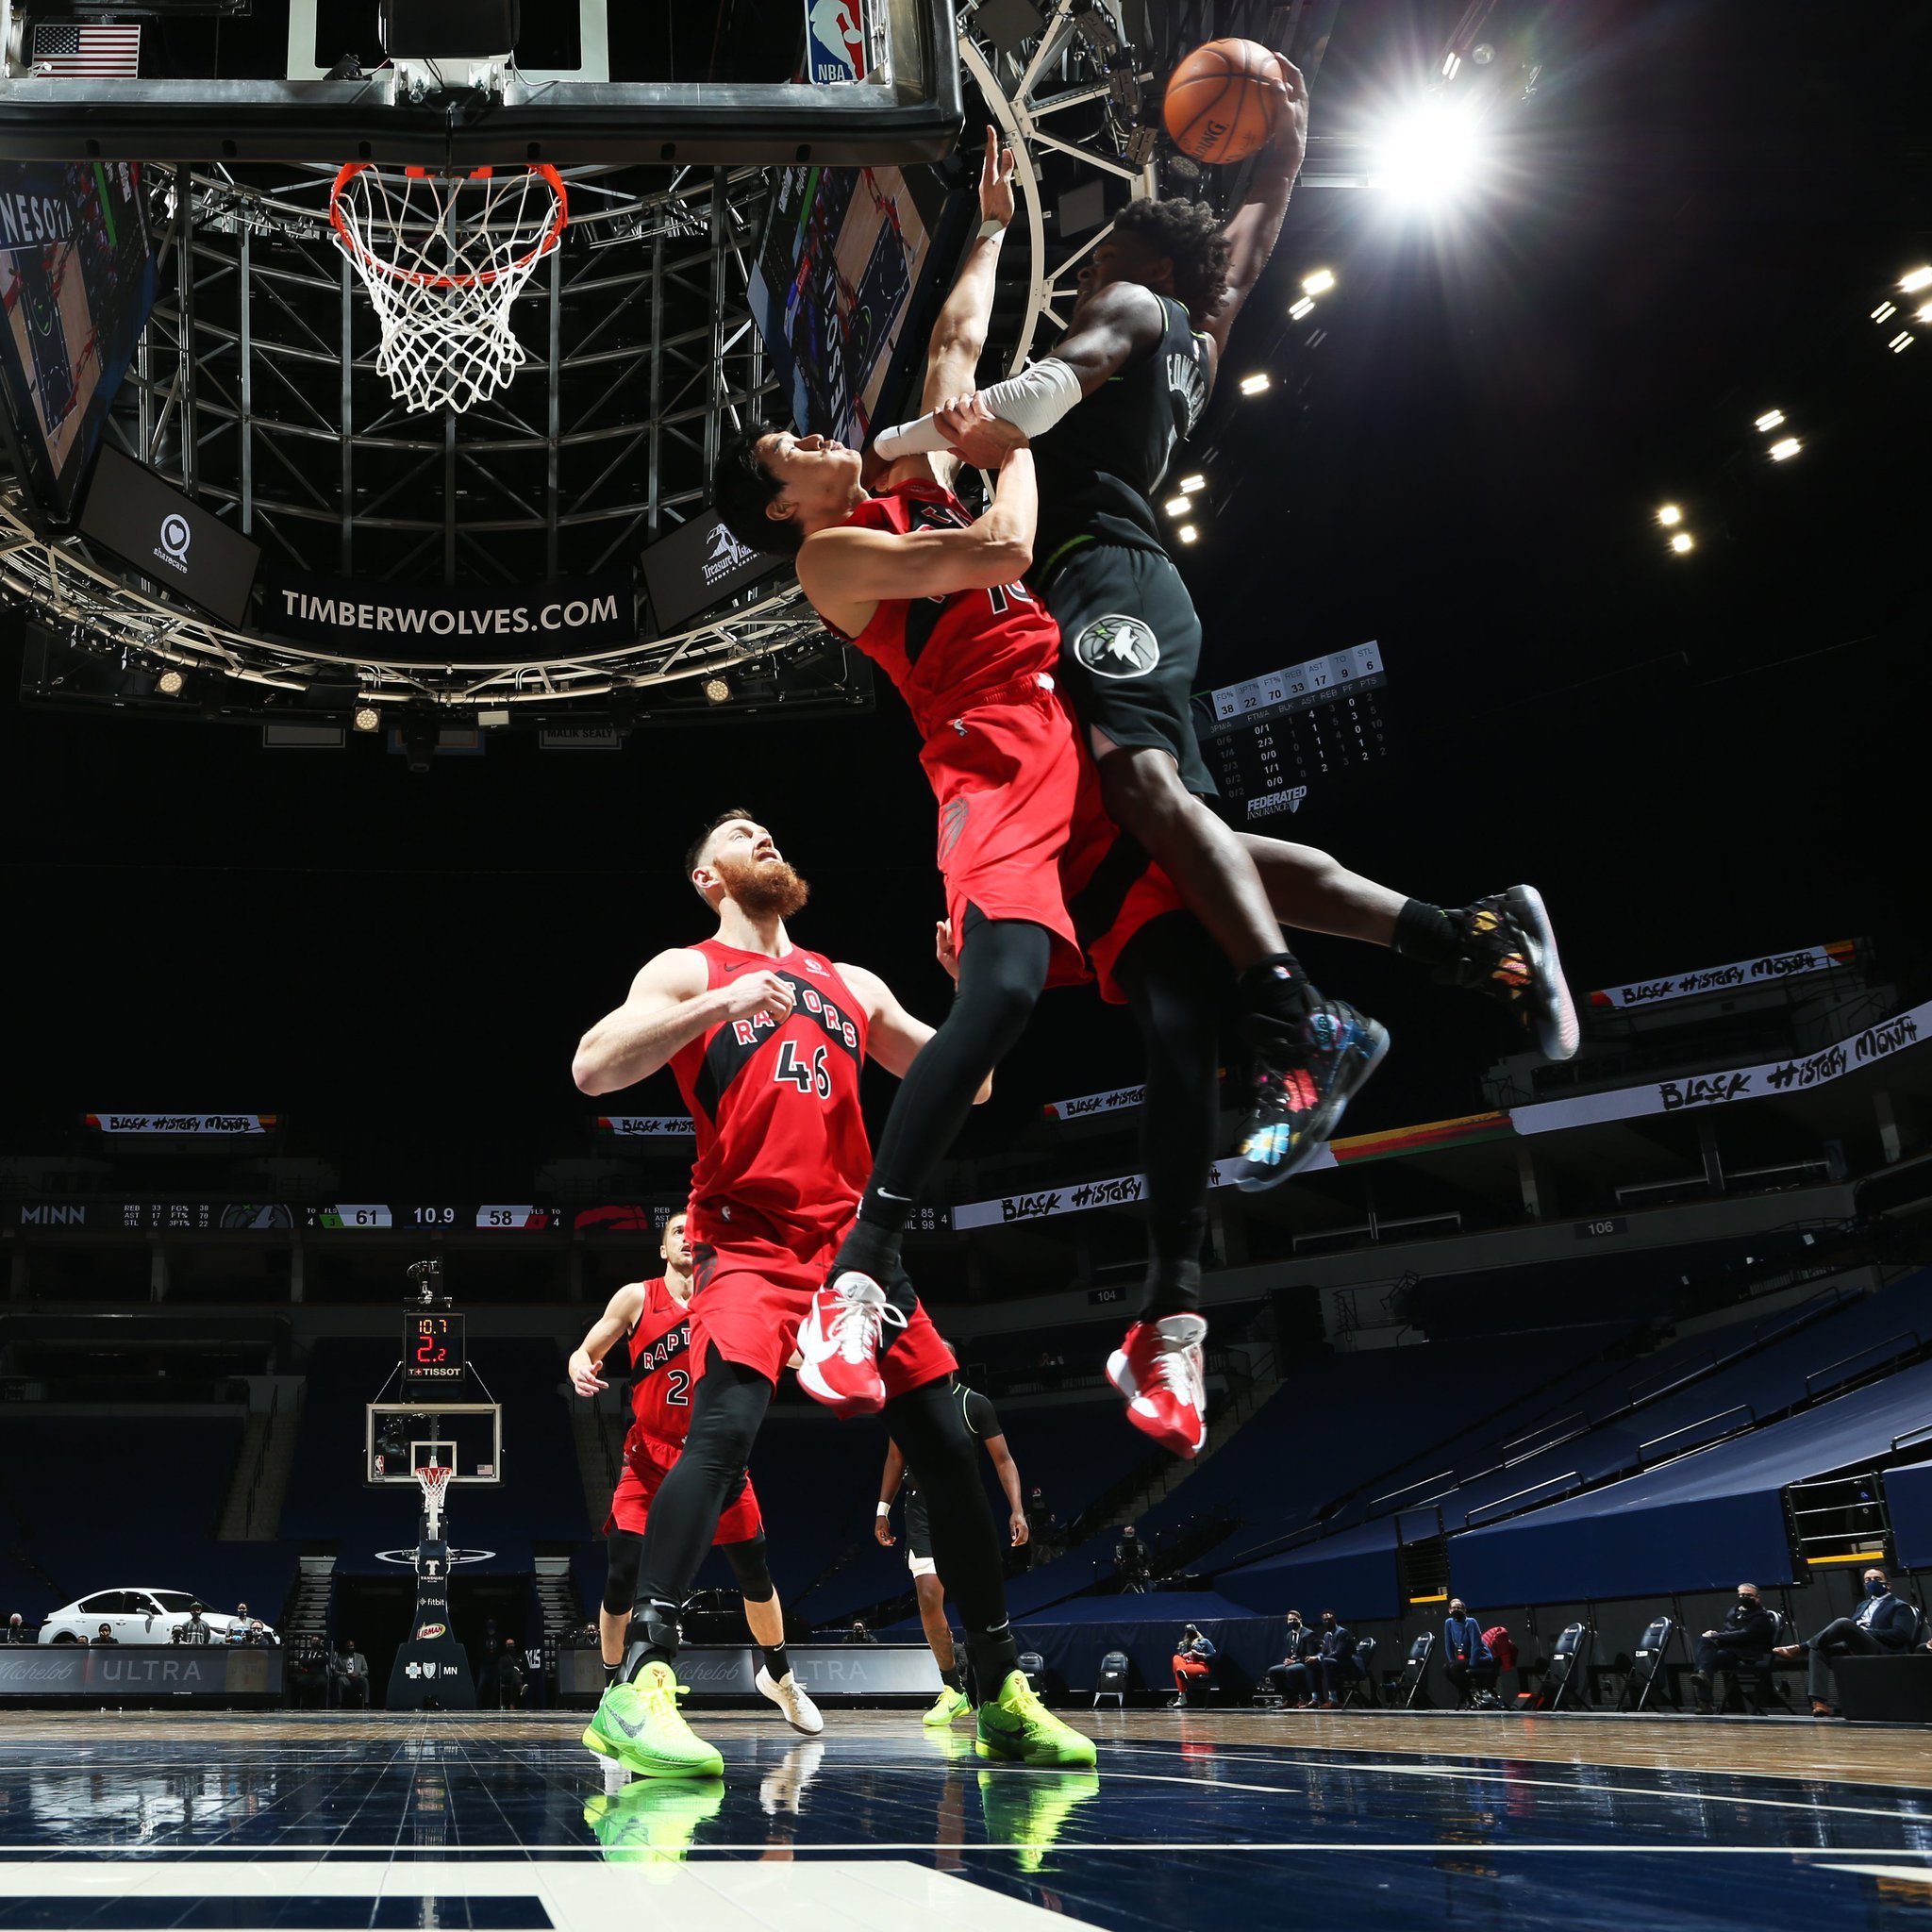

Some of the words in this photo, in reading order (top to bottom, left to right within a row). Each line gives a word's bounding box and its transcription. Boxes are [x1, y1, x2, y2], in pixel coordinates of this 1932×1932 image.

[818, 64, 845, 81] NBA
[153, 547, 188, 574] sharecare
[702, 555, 733, 579] Treasure
[281, 590, 618, 635] TIMBERWOLVES.COM
[1216, 691, 1234, 701] FG%
[1264, 676, 1281, 686] FT%
[1285, 670, 1302, 679] REB
[1308, 662, 1325, 672] AST
[1334, 656, 1346, 664] TO
[1357, 648, 1374, 657] STL
[1221, 704, 1234, 715] 38
[1244, 697, 1257, 708] 22
[1268, 690, 1282, 701] 70
[1291, 682, 1305, 693] 33
[1314, 675, 1326, 686] 17
[1341, 669, 1348, 677] 9
[1366, 660, 1374, 670] 6
[1302, 694, 1316, 705] AST
[1321, 689, 1338, 699] REB
[1342, 683, 1354, 692] PF
[1360, 677, 1377, 687] PTS
[1254, 724, 1270, 735] 0/1
[1308, 709, 1315, 718] 4
[1348, 698, 1356, 707] 0
[582, 728, 612, 738] SEALY
[1257, 737, 1274, 748] 2/3
[1312, 724, 1317, 732] 1
[1351, 711, 1358, 720] 3
[1260, 750, 1276, 760] 0/0
[1315, 737, 1321, 745] 1
[1355, 724, 1361, 734] 0
[1264, 762, 1279, 774] 1/1
[1319, 750, 1324, 758] 1
[1358, 738, 1364, 747] 1
[1267, 776, 1283, 788] 0/0
[1321, 763, 1328, 773] 2
[1361, 752, 1369, 761] 2
[1247, 785, 1307, 812] FEDERATED
[1247, 802, 1289, 821] INSURANCE
[774, 1041, 831, 1100] 46
[21, 1206, 85, 1224] MINN
[308, 1217, 314, 1226] 4
[356, 1209, 378, 1225] 61
[413, 1208, 455, 1224] 10.9
[489, 1210, 513, 1225] 58
[553, 1217, 559, 1226] 4
[921, 1208, 934, 1218] 85
[941, 1215, 947, 1224] 4
[922, 1221, 935, 1230] 98
[1588, 1222, 1613, 1235] 106
[1098, 1291, 1116, 1302] 104
[419, 1320, 446, 1334] 10.7
[417, 1336, 446, 1362] 2.2
[666, 1369, 690, 1406] 2
[416, 1626, 443, 1639] LIBMAN
[103, 1660, 203, 1680] ULTRA
